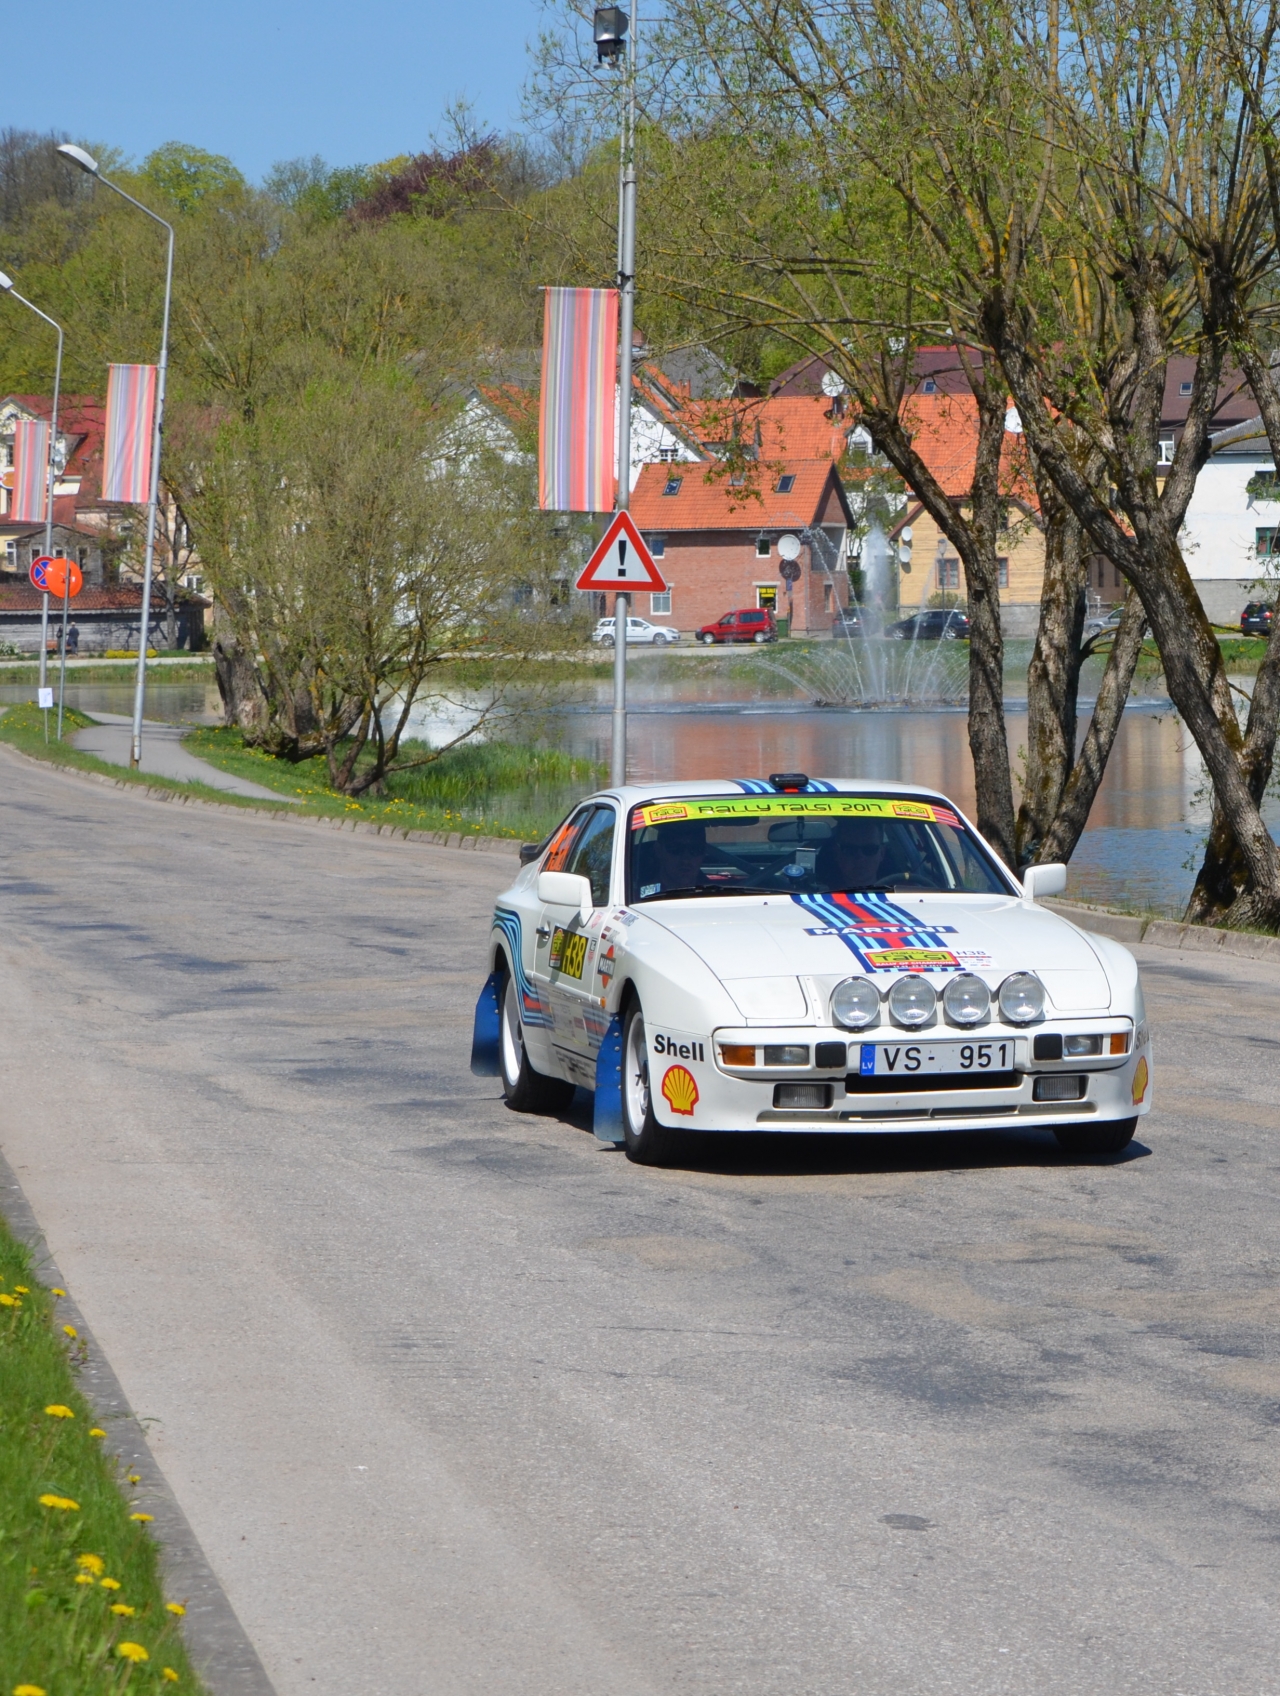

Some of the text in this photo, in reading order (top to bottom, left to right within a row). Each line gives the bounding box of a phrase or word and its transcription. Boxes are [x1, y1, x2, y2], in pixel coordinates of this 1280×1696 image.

[841, 802, 883, 812] 2017
[812, 926, 948, 935] MARTINI
[562, 934, 587, 979] H38
[653, 1033, 705, 1063] Shell
[959, 1043, 1007, 1069] 951
[862, 1061, 874, 1070] LV
